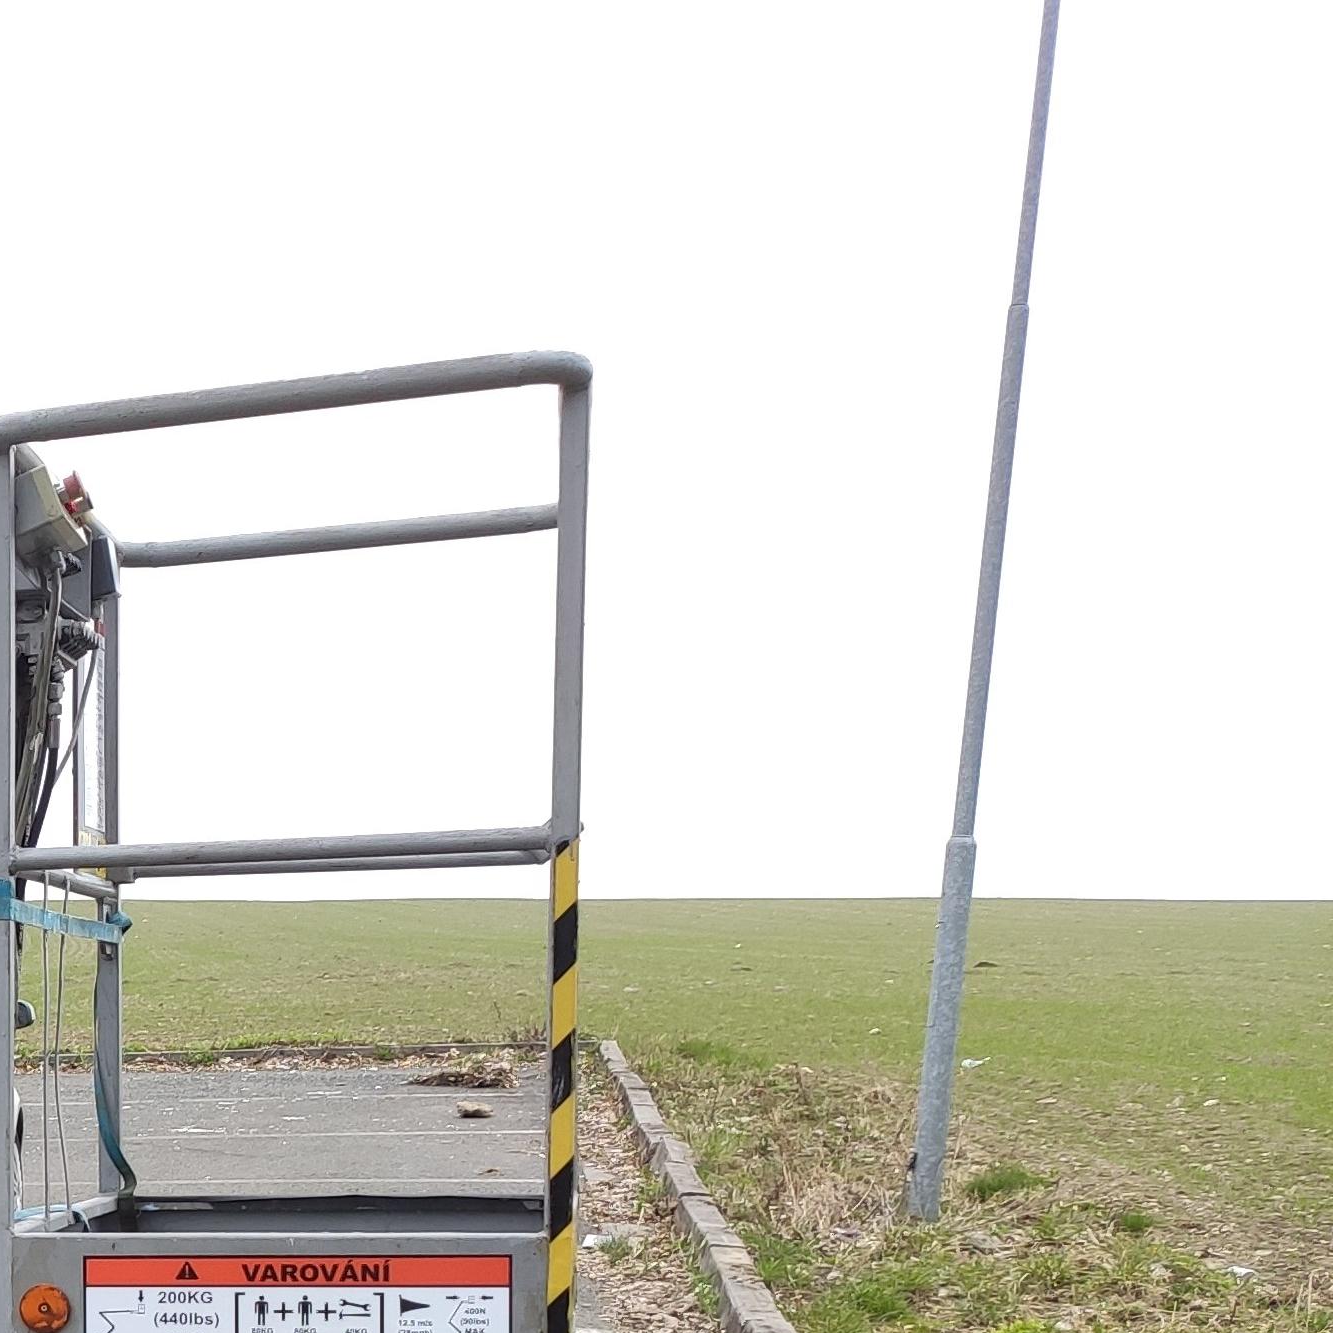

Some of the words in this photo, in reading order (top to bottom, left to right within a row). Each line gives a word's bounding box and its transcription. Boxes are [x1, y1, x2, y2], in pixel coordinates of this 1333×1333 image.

[241, 1259, 391, 1284] VAROVÁNÍ
[157, 1290, 214, 1305] 200KG
[152, 1311, 220, 1328] (440lbs)
